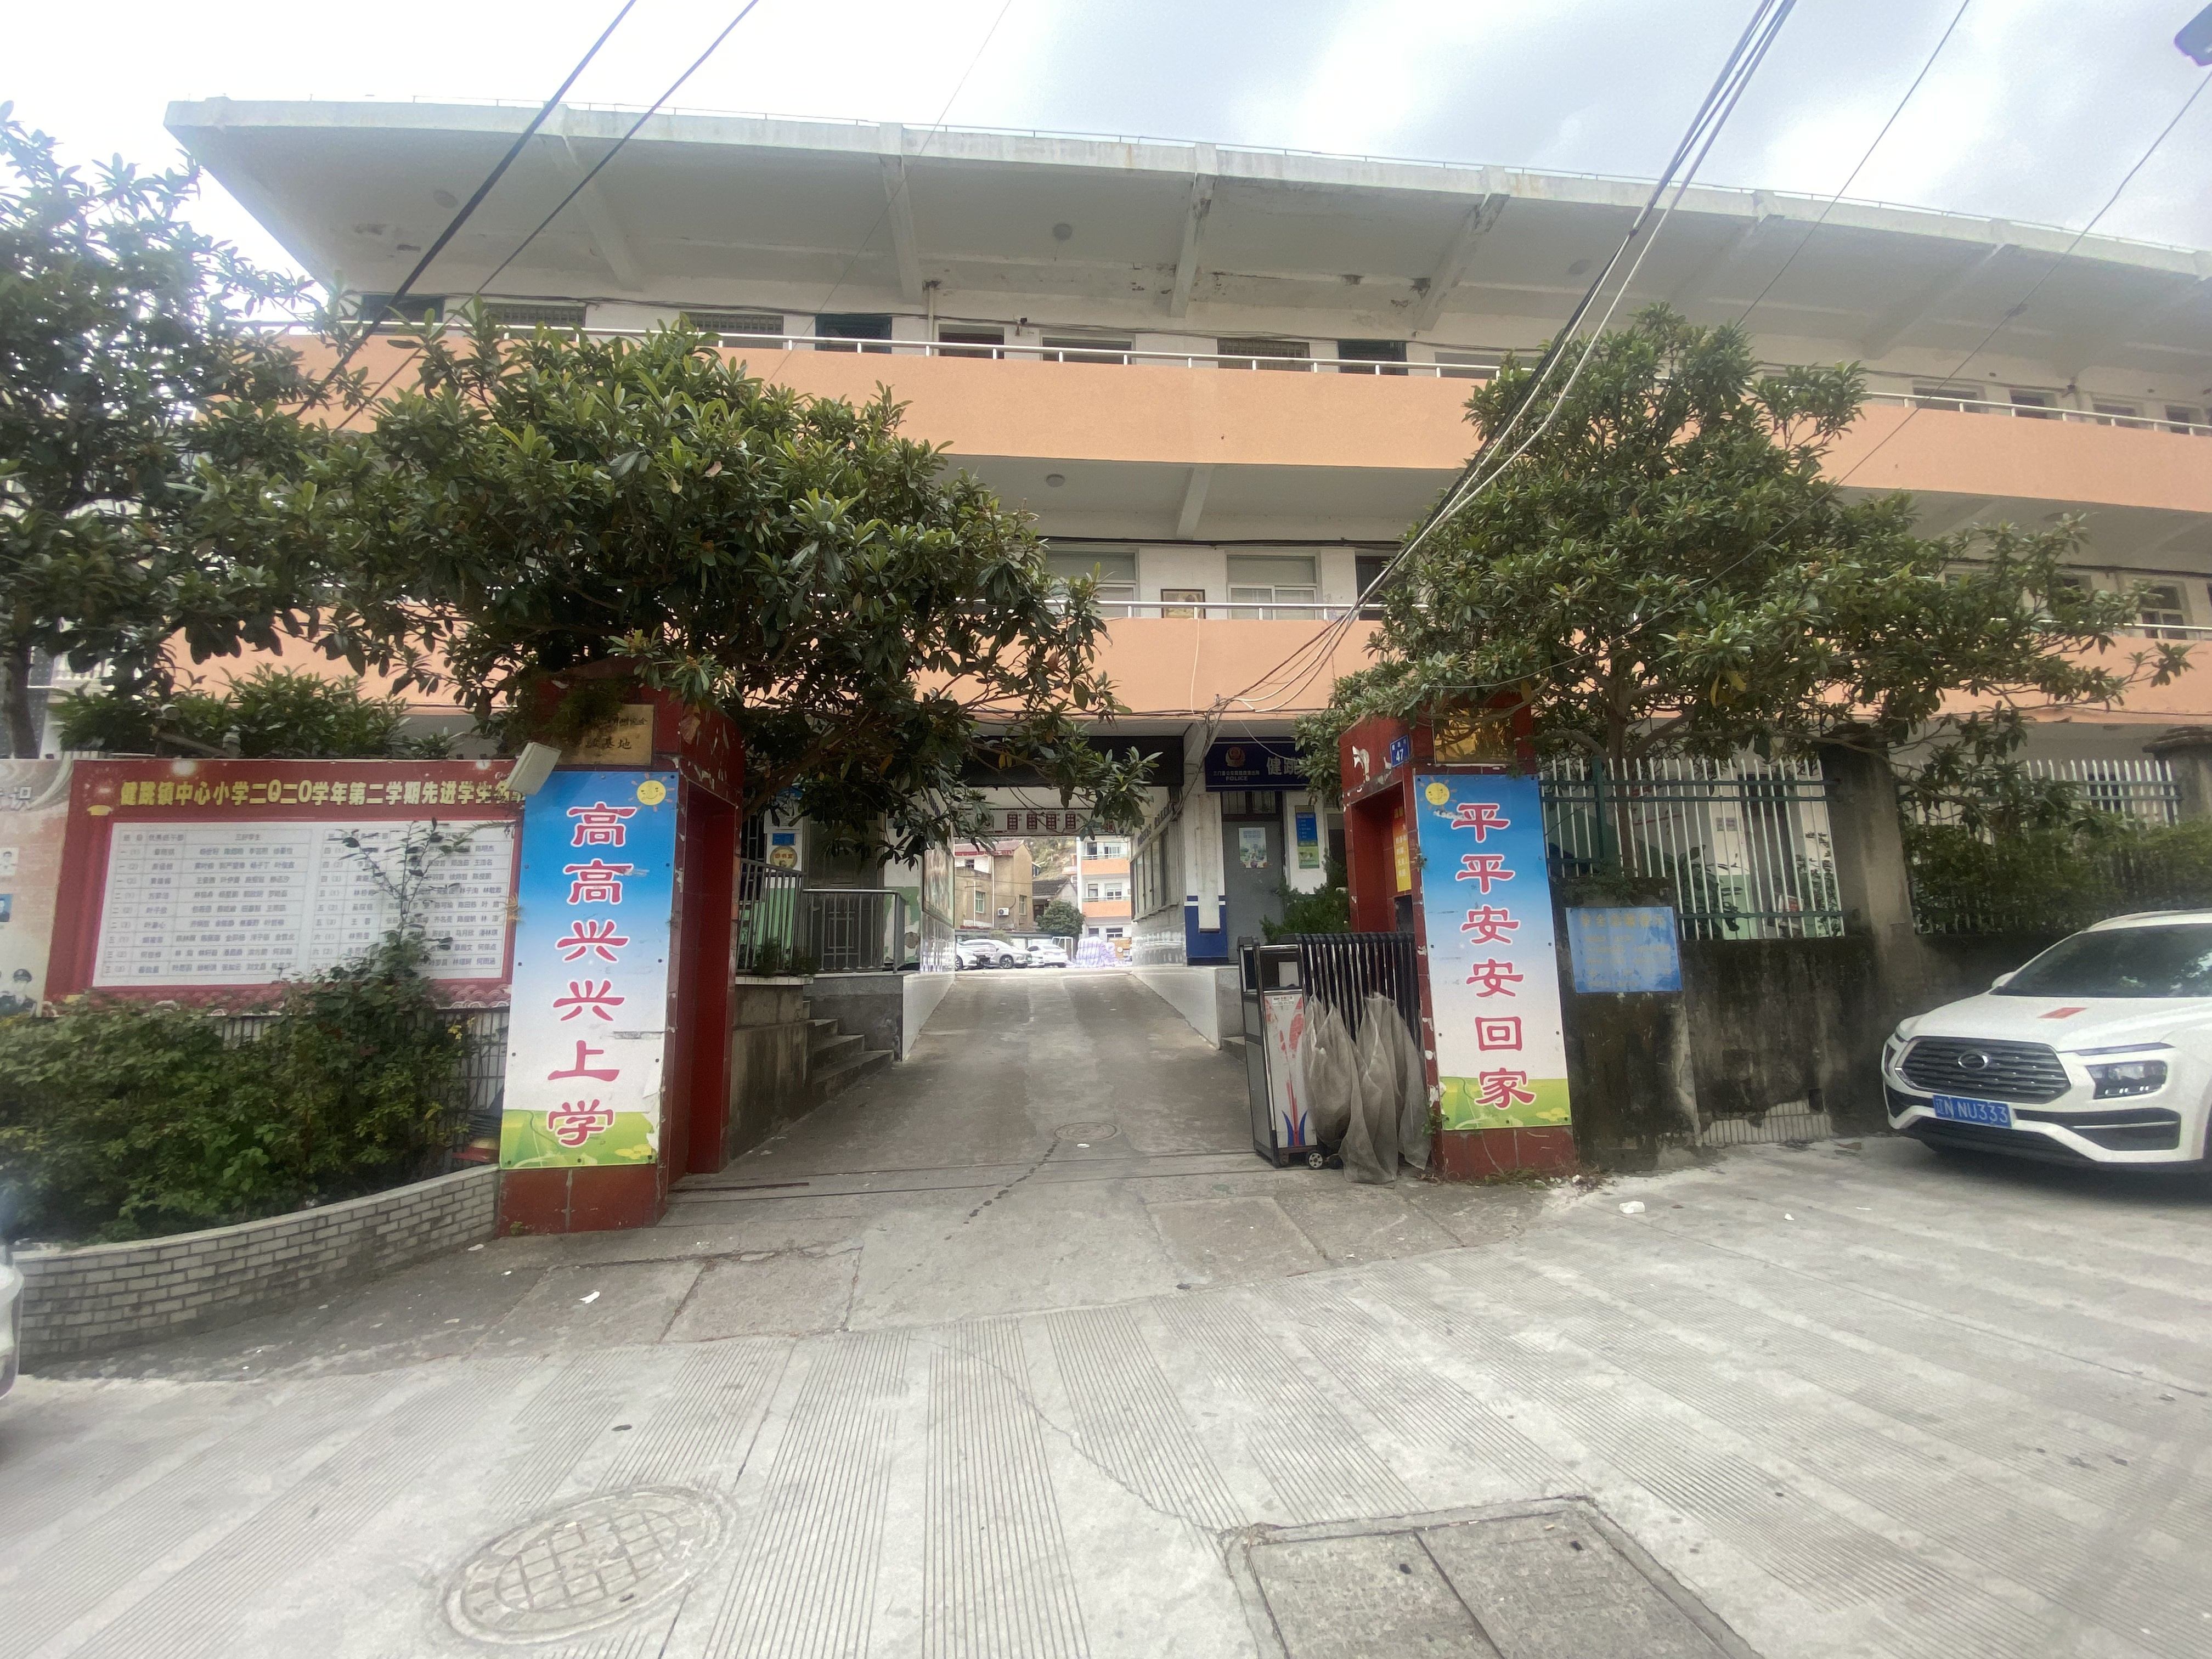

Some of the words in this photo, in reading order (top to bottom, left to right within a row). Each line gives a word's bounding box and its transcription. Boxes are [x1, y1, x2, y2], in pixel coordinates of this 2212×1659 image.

[1396, 748, 1404, 762] 47
[548, 802, 636, 1147] 高高兴兴上学
[1451, 802, 1537, 1110] 平平安安回家
